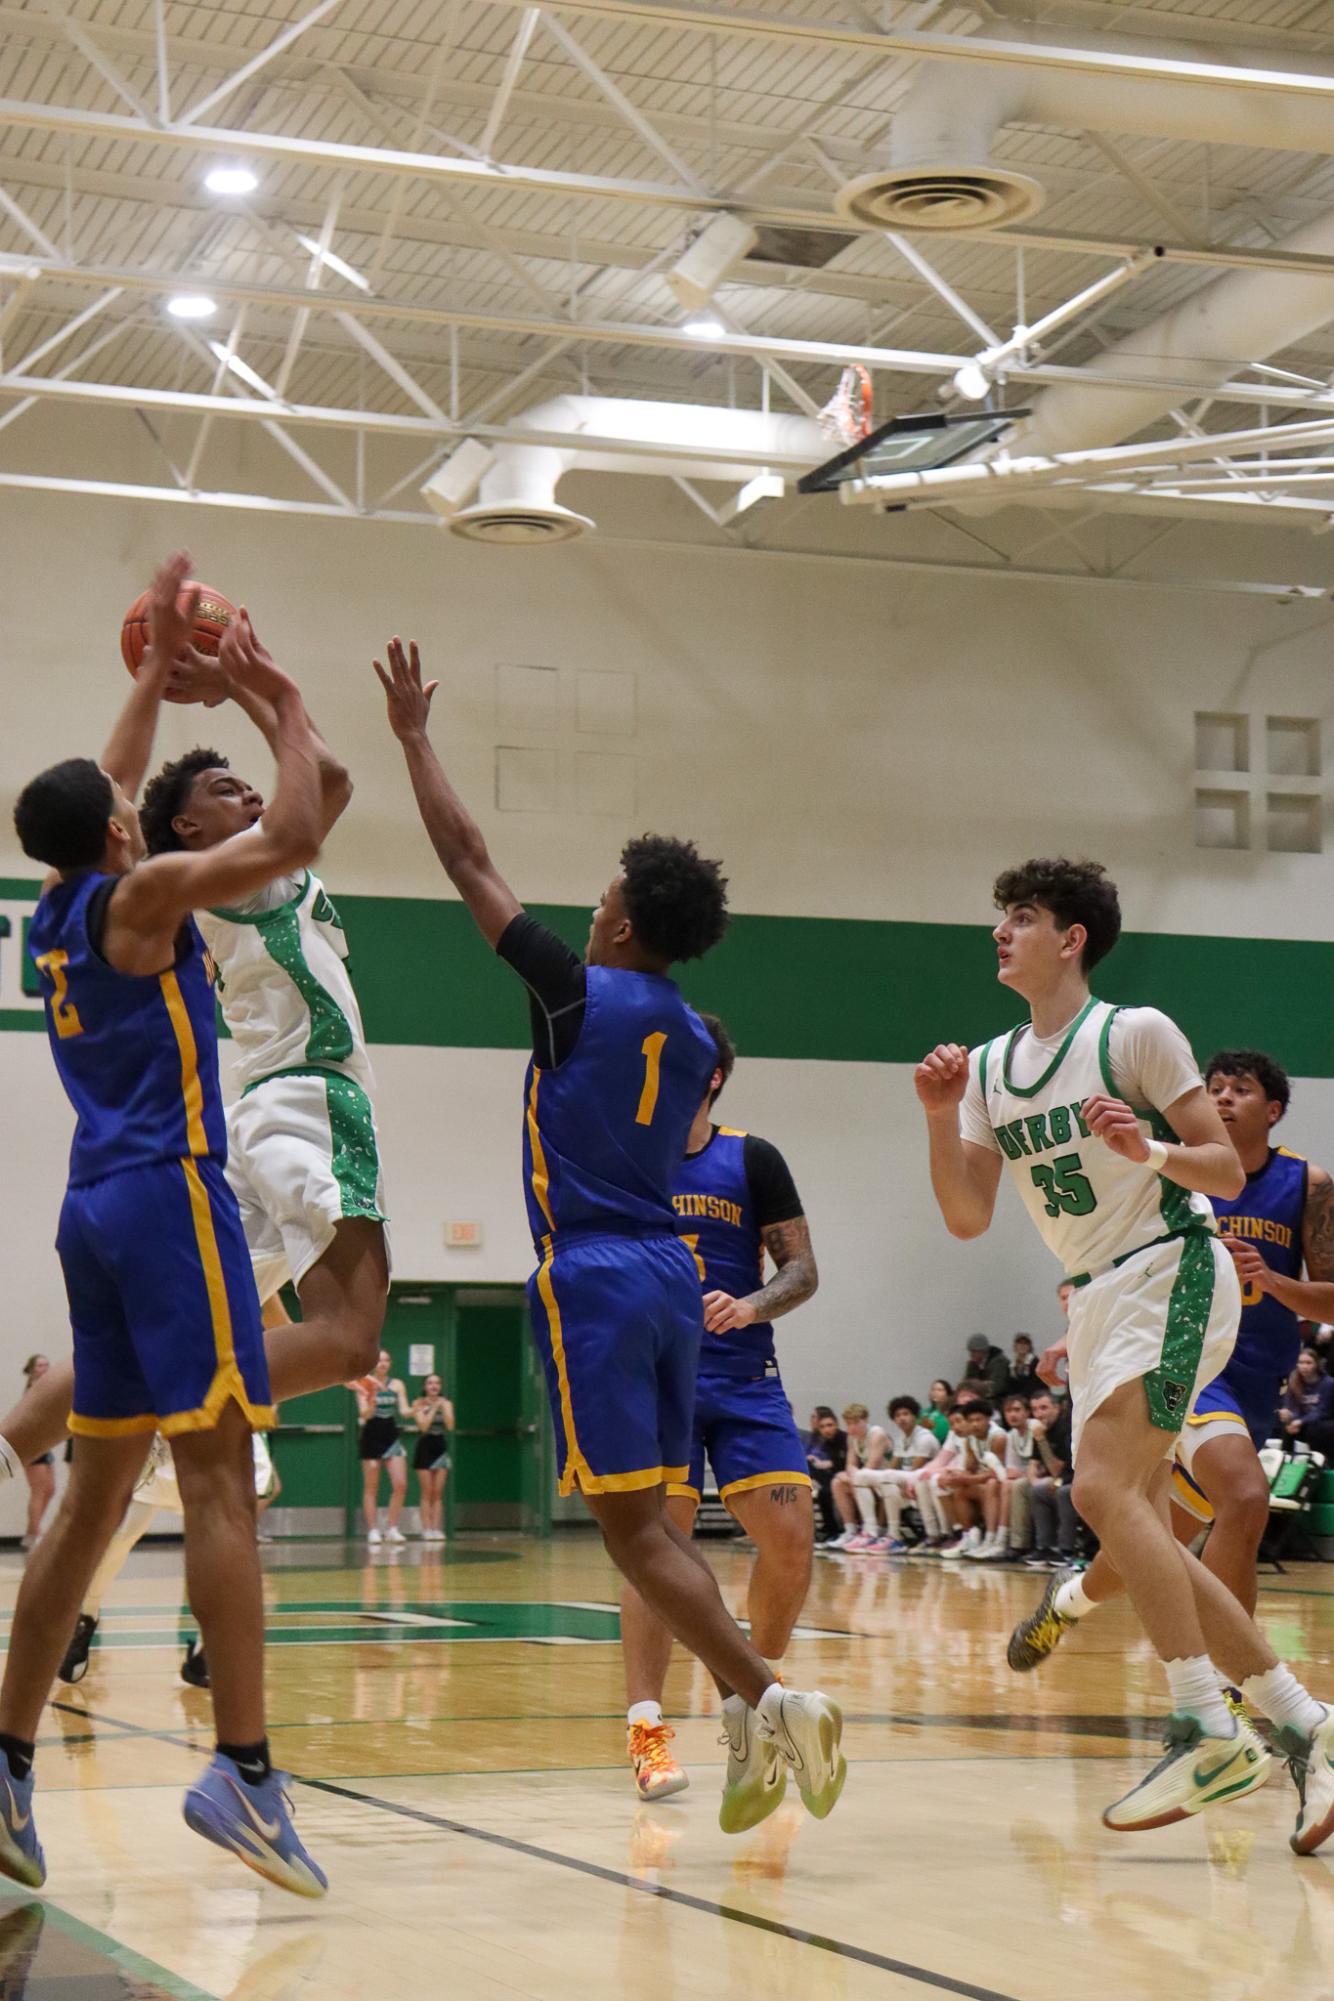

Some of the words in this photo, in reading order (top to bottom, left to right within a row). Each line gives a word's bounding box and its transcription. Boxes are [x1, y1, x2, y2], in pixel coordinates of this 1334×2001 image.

[35, 948, 84, 1040] 2
[635, 1031, 668, 1126] 1
[1030, 1152, 1098, 1218] 35
